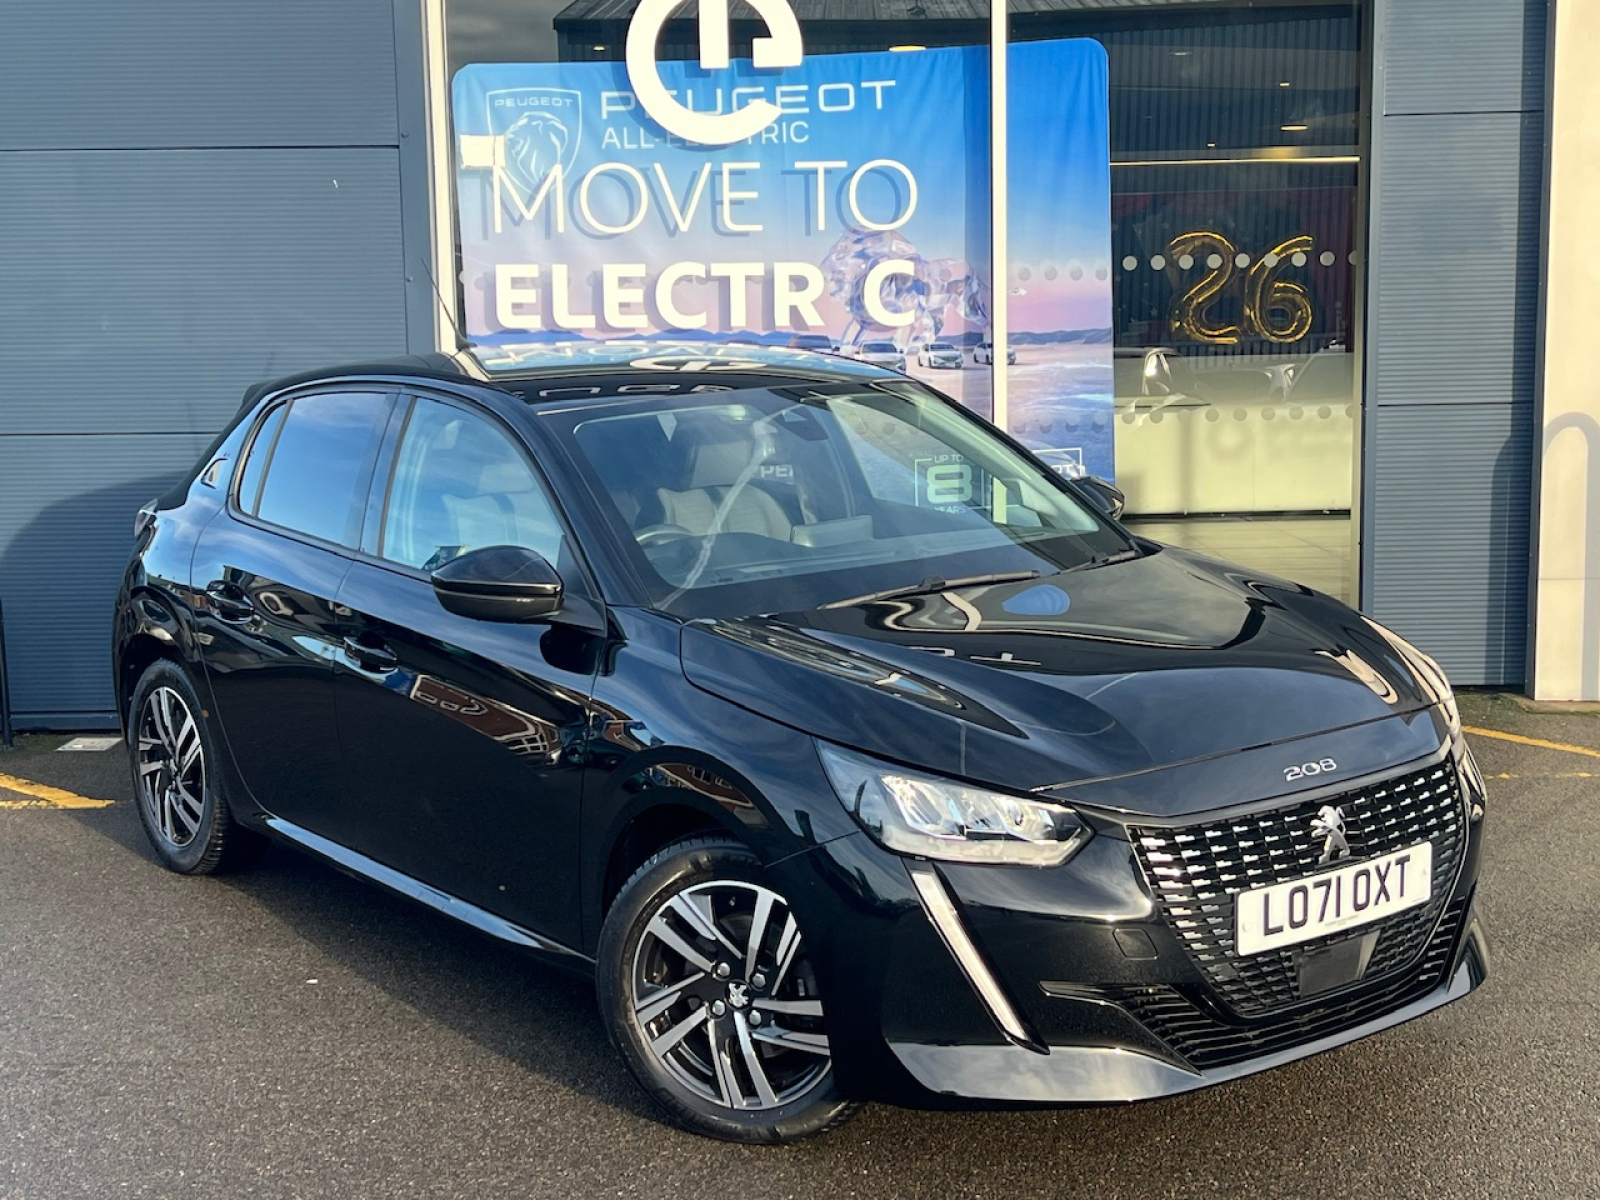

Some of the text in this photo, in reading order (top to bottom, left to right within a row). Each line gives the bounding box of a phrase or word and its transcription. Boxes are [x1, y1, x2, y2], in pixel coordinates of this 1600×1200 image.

[495, 97, 573, 107] PEUGEOT
[492, 159, 918, 234] MOVE TO
[934, 454, 964, 463] UP TO
[926, 464, 972, 504] 8
[1283, 758, 1337, 782] 208
[1263, 854, 1411, 936] LO71 OXT
